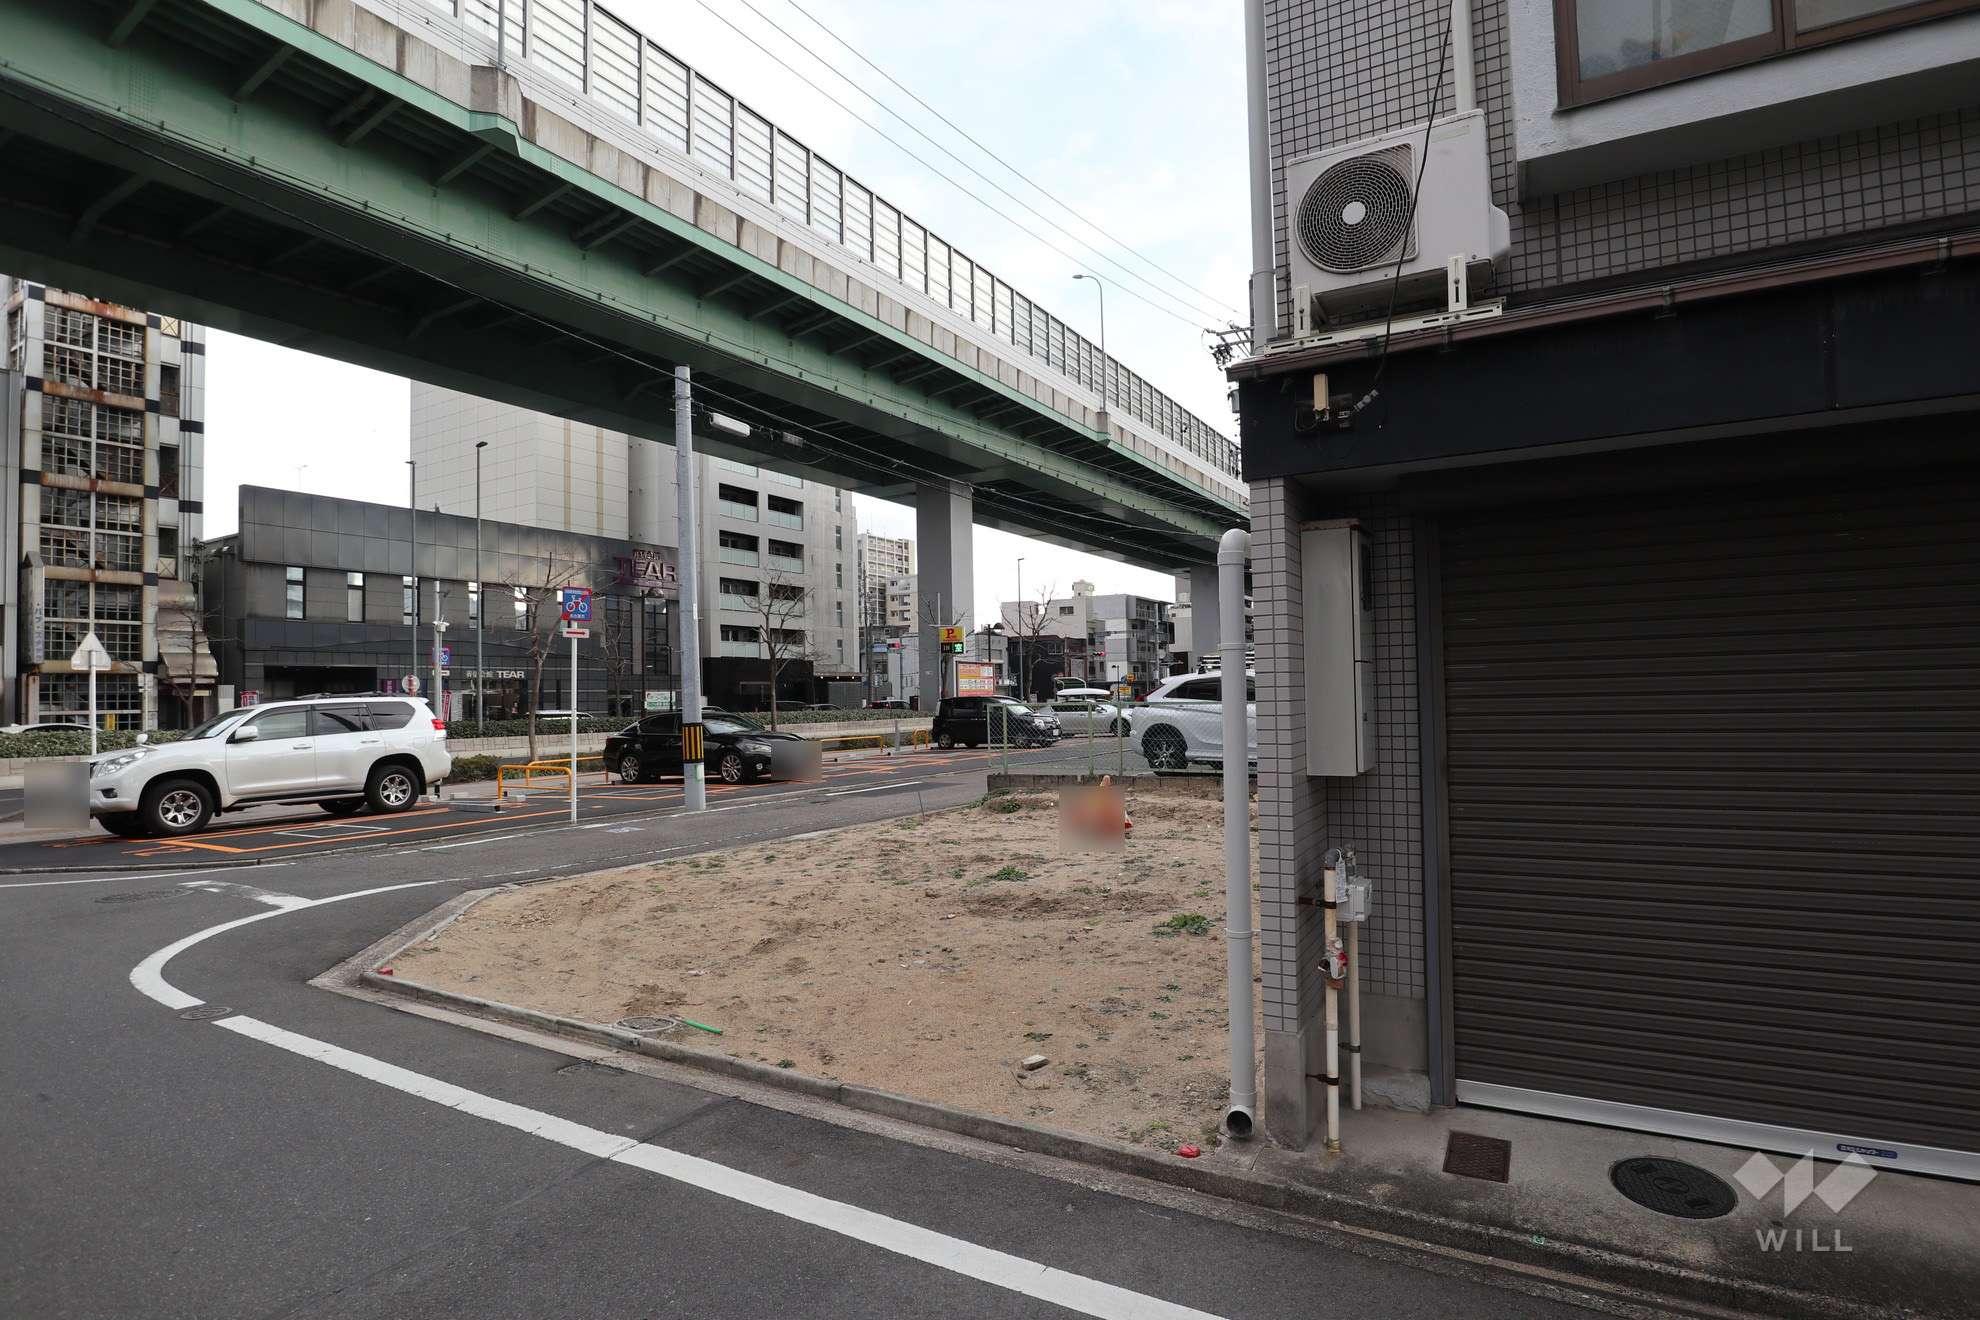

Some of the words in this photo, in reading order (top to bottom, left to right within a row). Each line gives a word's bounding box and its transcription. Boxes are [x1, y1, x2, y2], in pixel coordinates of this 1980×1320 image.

[613, 556, 677, 583] TEAR
[945, 627, 955, 639] P
[496, 670, 525, 679] TEAR
